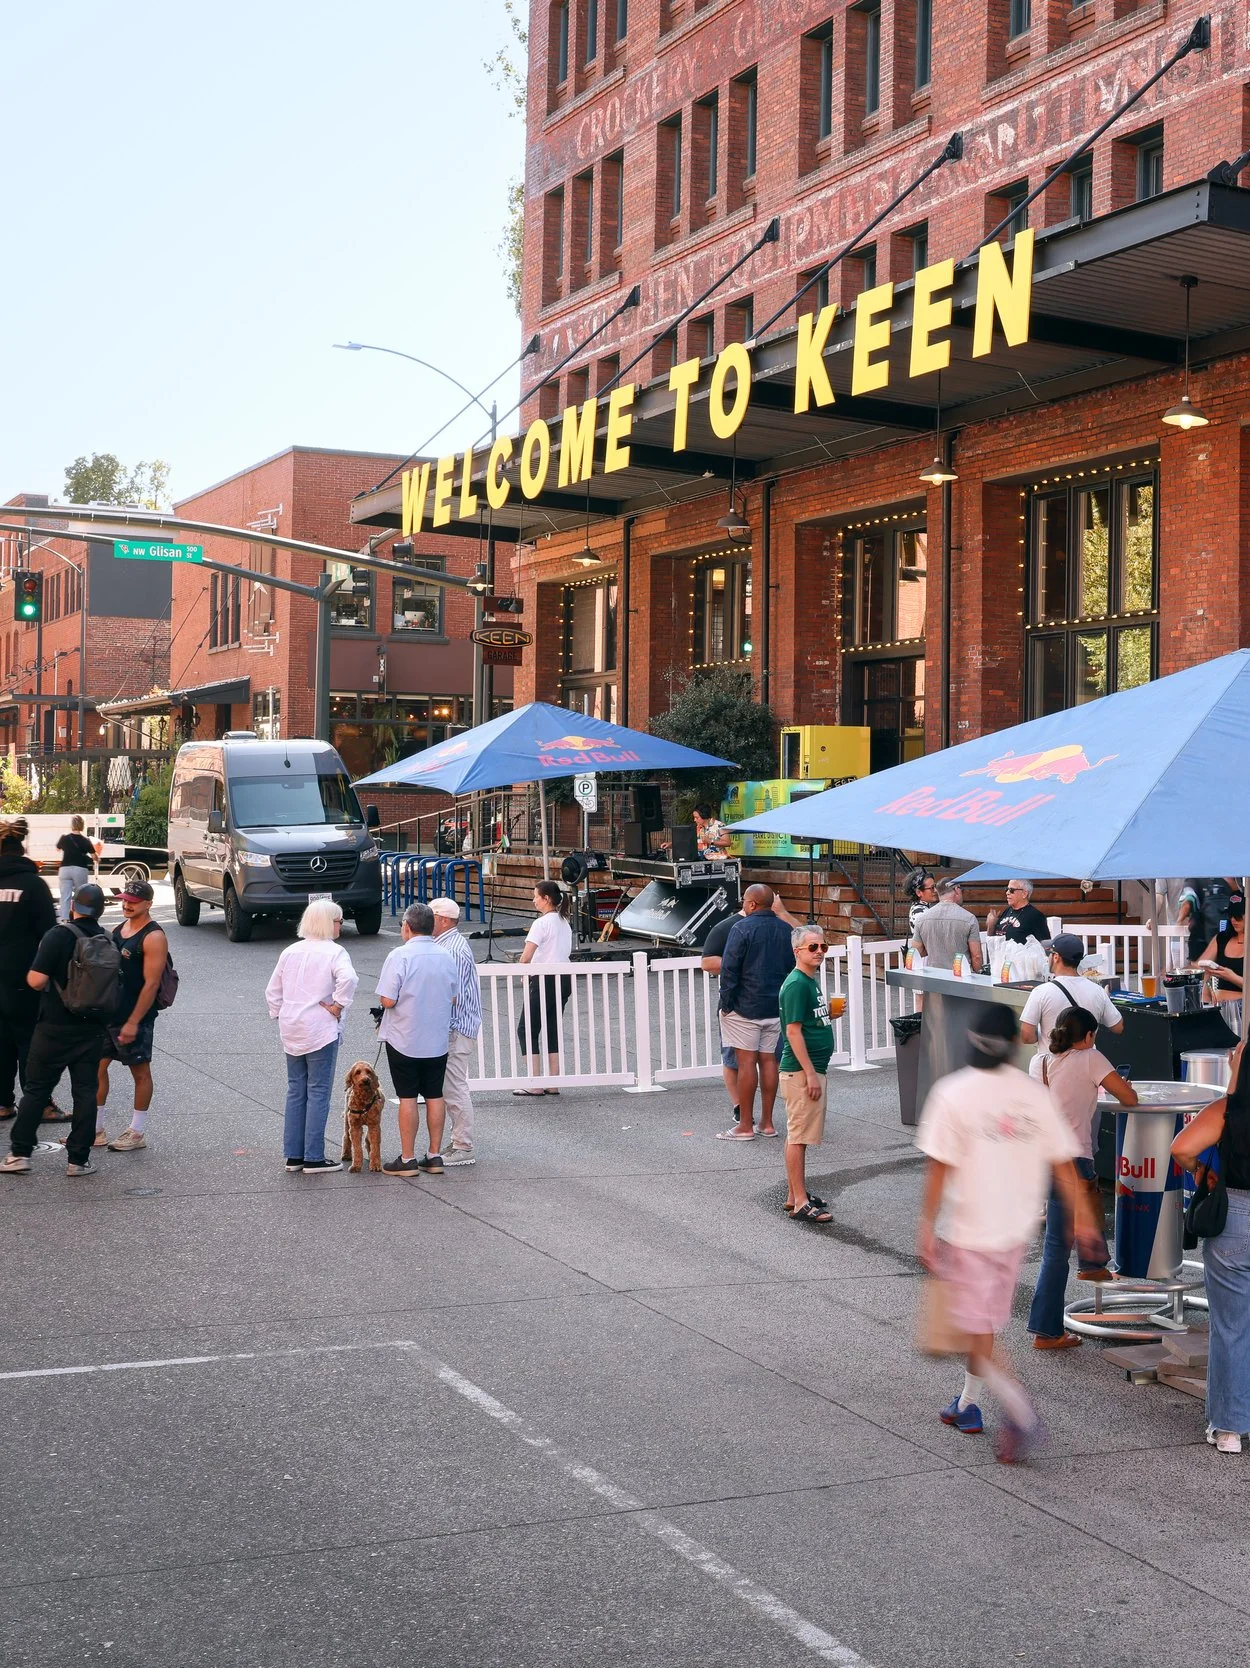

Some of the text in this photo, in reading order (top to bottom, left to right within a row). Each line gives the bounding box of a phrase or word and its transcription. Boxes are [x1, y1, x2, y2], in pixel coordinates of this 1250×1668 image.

[401, 228, 1035, 538] WELCOME TO KEEN
[133, 545, 182, 558] NW Glisan
[475, 630, 530, 645] KEEN
[488, 650, 518, 661] GARAGE
[539, 750, 641, 767] Red Bull
[873, 786, 1056, 827] Red Bull
[1120, 1156, 1155, 1179] Bull
